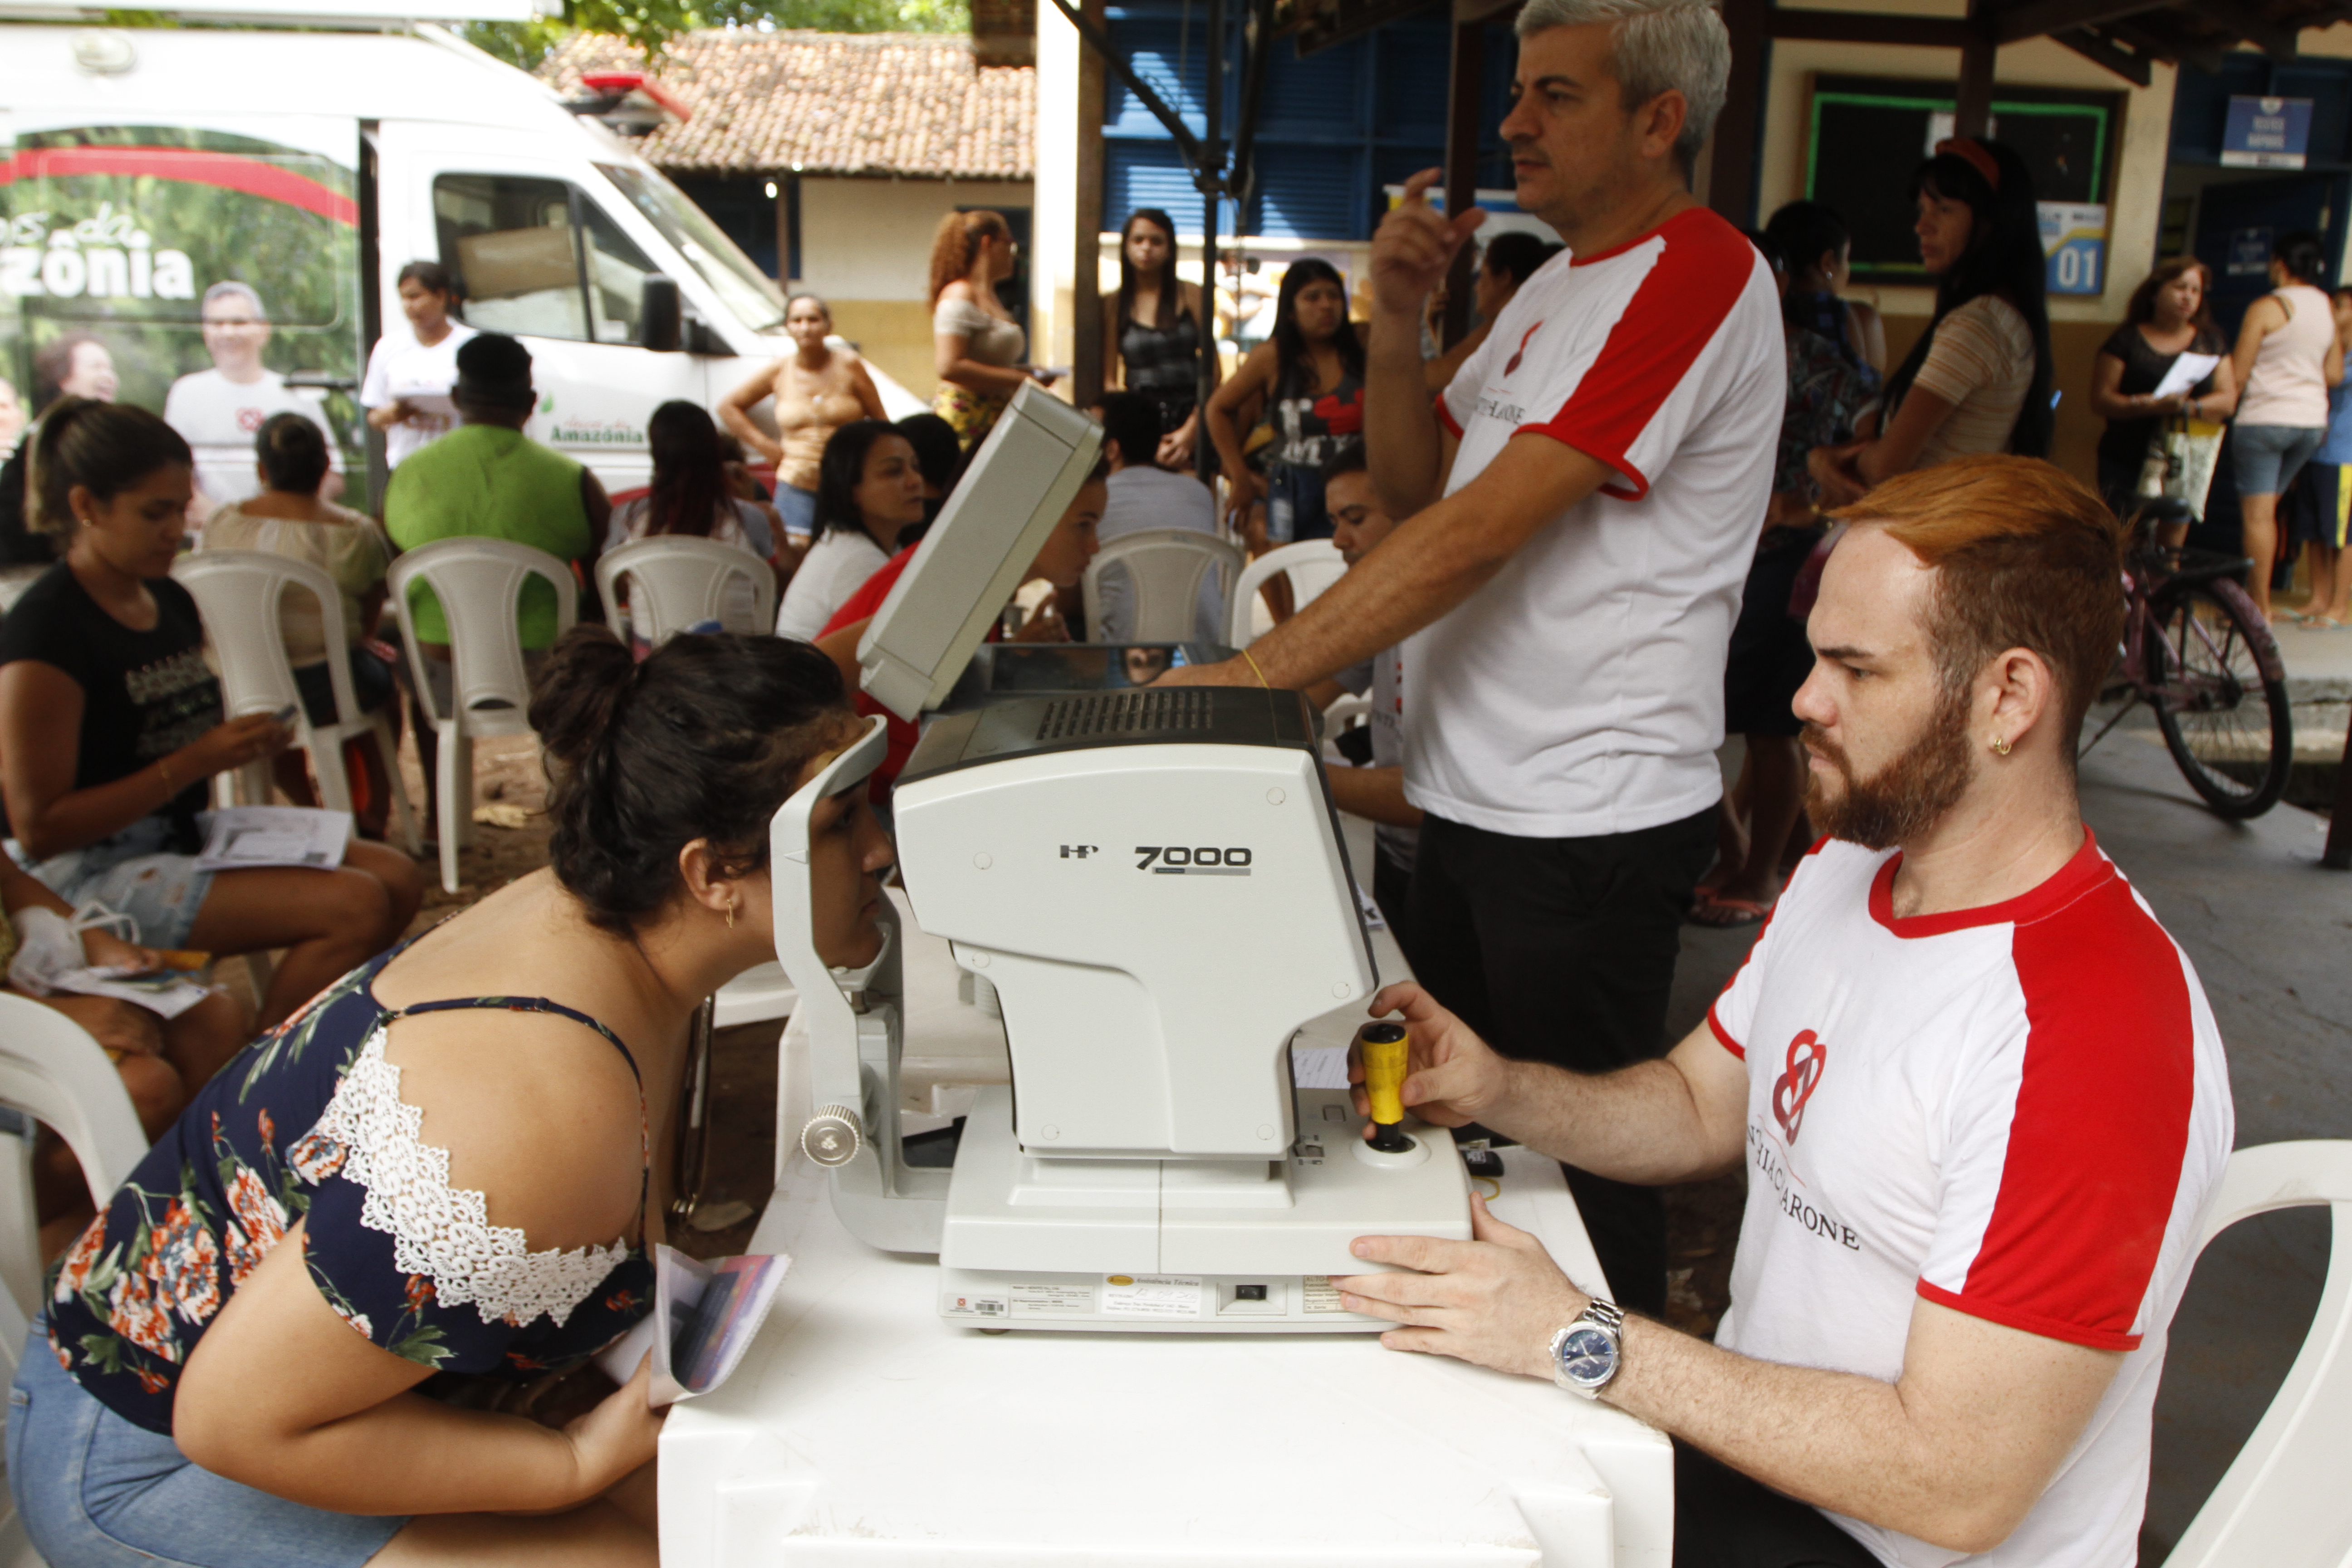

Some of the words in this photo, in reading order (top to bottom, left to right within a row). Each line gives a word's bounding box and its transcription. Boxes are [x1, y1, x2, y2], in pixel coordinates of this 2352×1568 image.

[2058, 246, 2097, 289] 01
[550, 425, 643, 442] Amazônia
[1135, 846, 1251, 870] 7000
